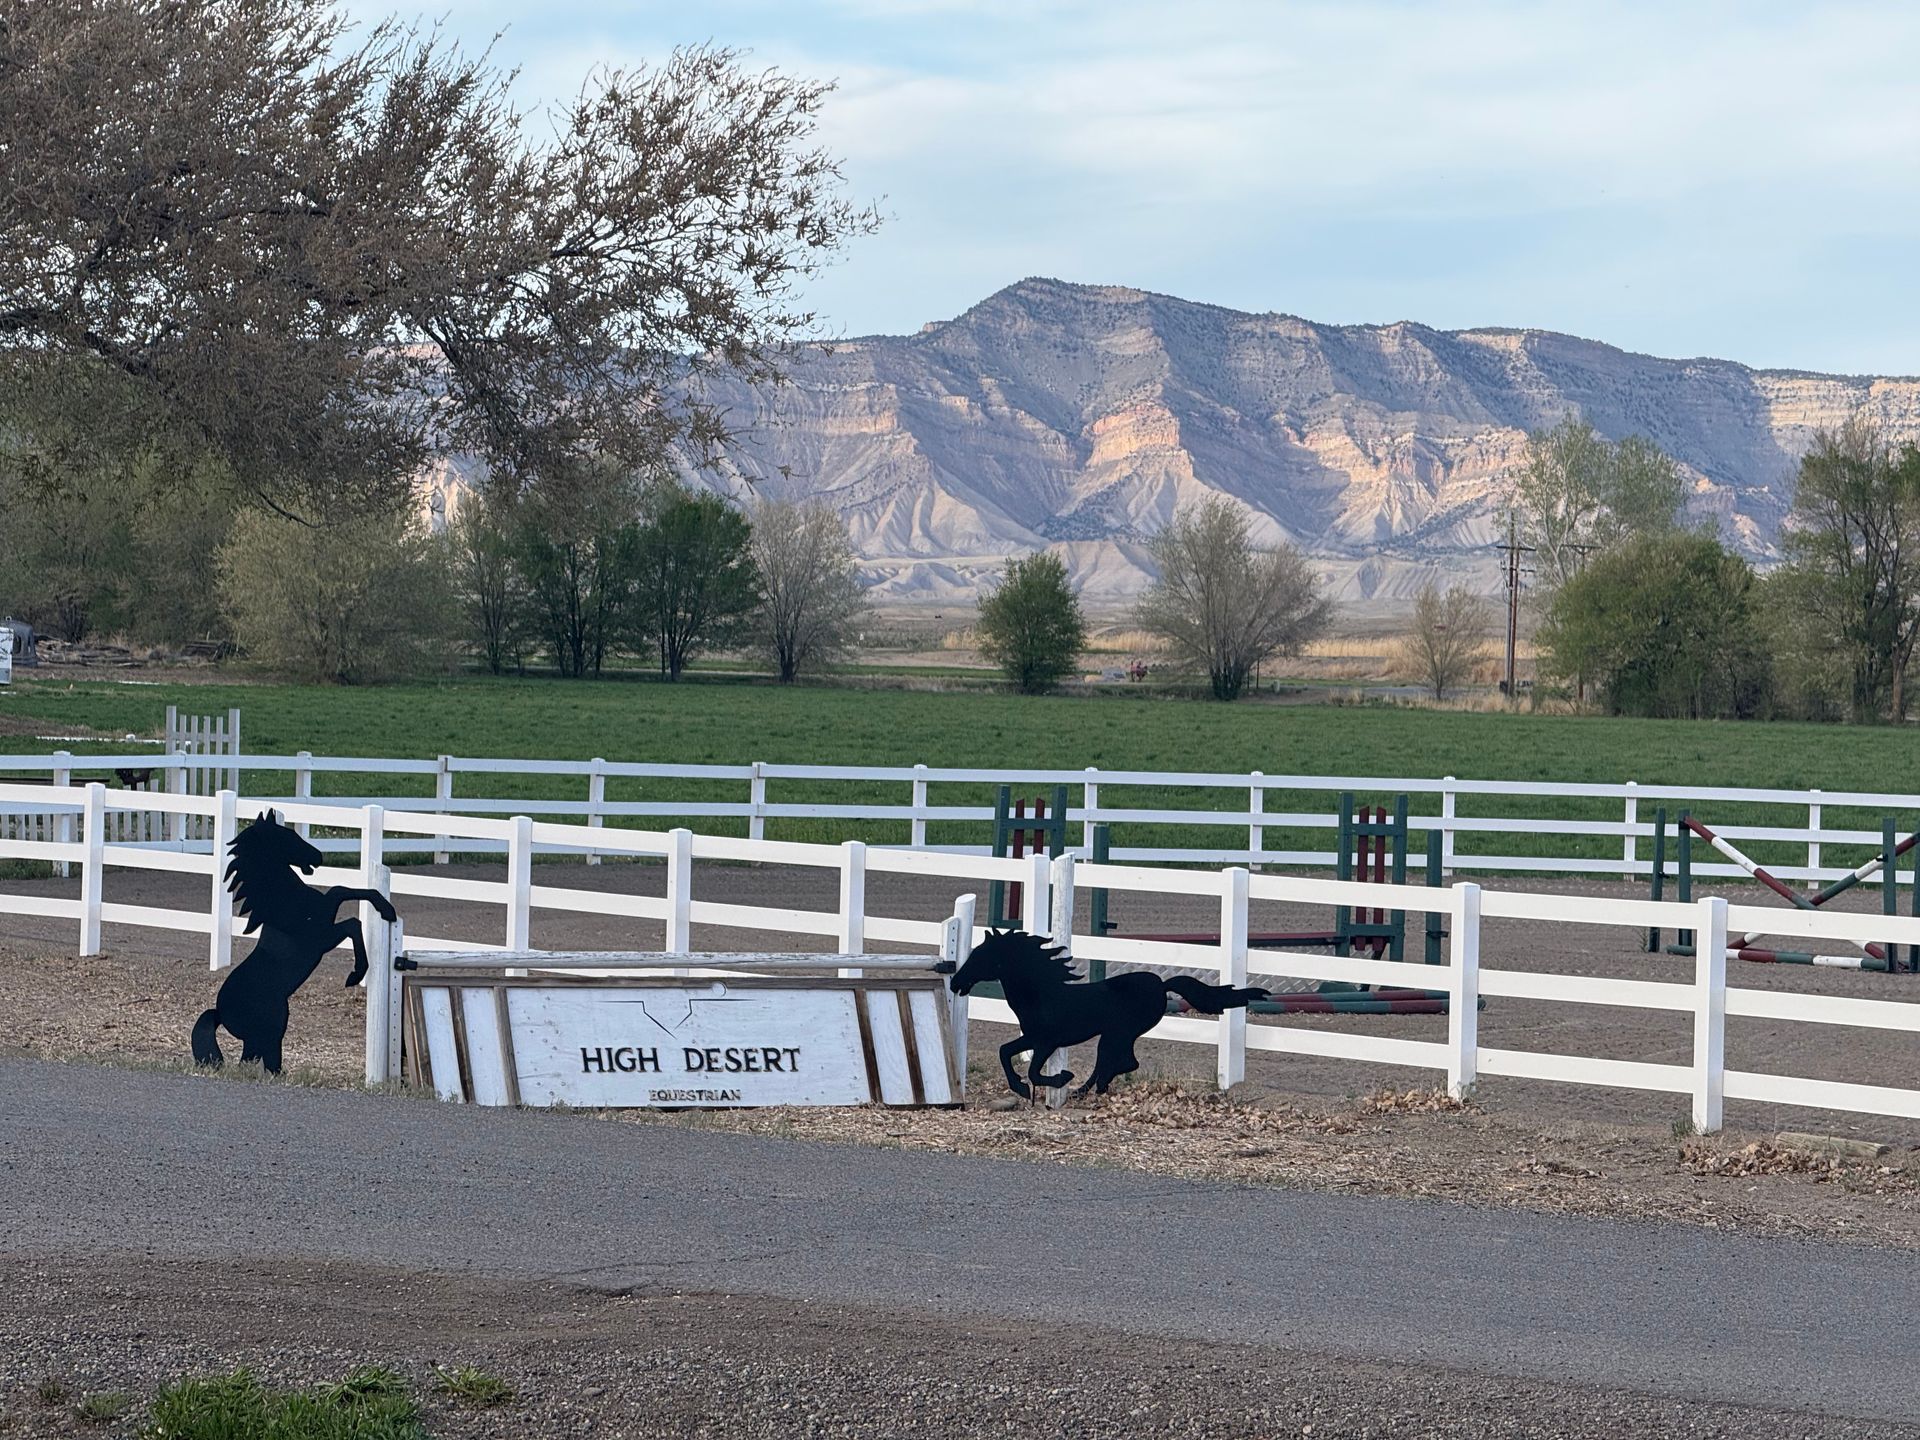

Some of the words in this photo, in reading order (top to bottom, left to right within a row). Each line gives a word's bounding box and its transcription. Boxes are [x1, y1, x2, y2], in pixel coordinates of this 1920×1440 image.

[580, 1047, 662, 1073] HIGH
[681, 1046, 801, 1073] DESERT
[648, 1089, 742, 1102] EQUESTRIAN
